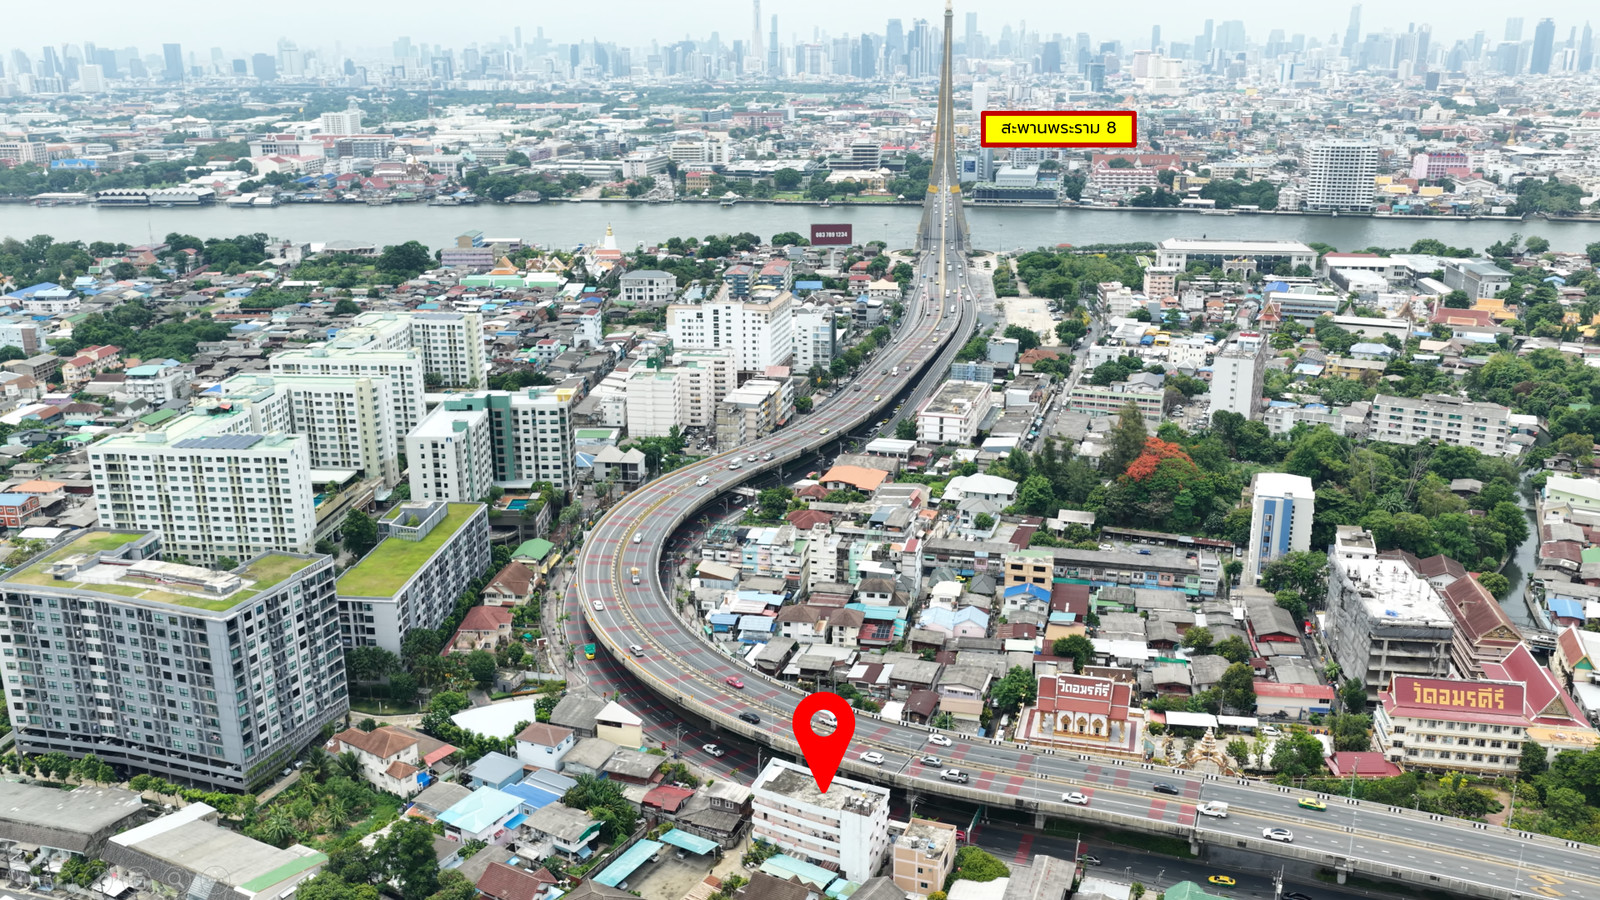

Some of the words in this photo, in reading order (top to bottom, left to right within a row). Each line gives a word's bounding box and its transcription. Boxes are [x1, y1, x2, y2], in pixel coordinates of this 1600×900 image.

[1058, 678, 1110, 697] วัดอมรคีรี
[1413, 682, 1504, 710] วัดอมรคีรี
